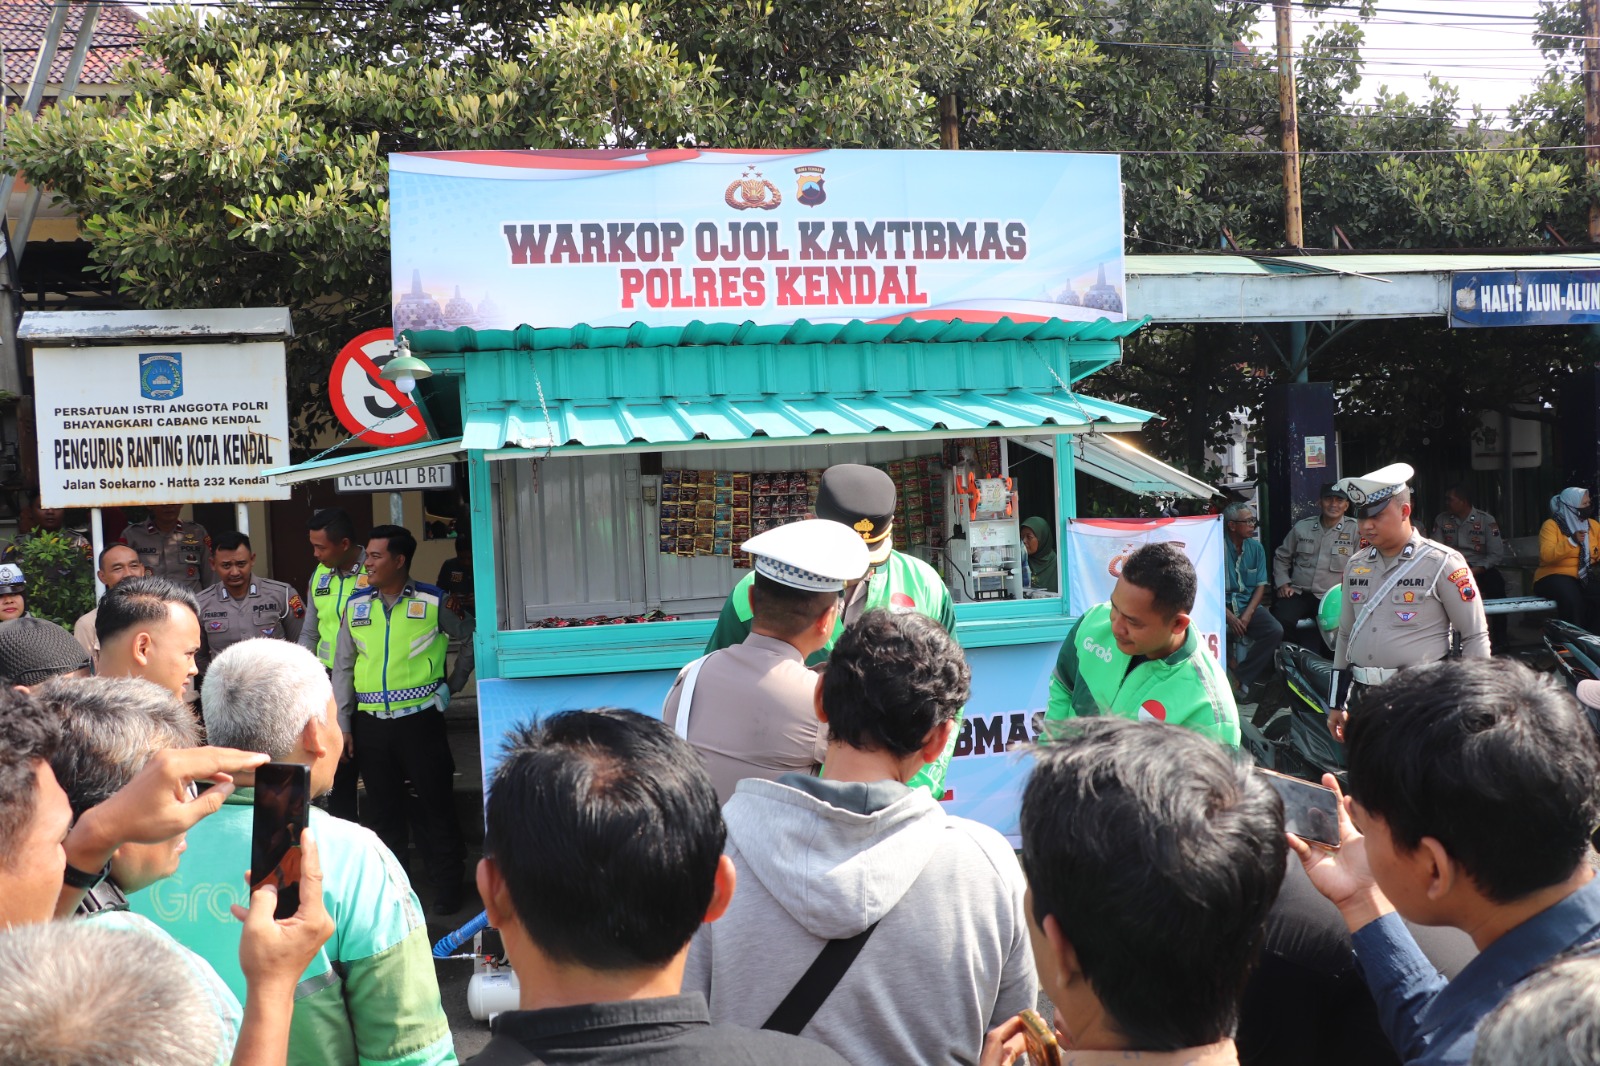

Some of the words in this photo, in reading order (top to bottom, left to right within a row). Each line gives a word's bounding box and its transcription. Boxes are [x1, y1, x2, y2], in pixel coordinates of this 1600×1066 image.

[504, 222, 684, 264] WARKOP
[695, 221, 790, 261] OJOL
[798, 221, 1027, 260] KAMTIBMAS
[620, 266, 766, 308] POLRES
[776, 265, 928, 306] KENDAL
[1481, 285, 1522, 312] HALTE
[1527, 283, 1600, 311] ALUN-ALUN
[55, 406, 129, 416] PERSATUAN
[133, 405, 165, 414] ISTRI
[169, 402, 228, 413] ANGGOTA
[232, 401, 268, 411] POLRI
[63, 418, 153, 430] BHAYANGKARI
[157, 416, 208, 427] CABANG
[213, 414, 261, 425] KENDAL
[54, 436, 123, 470] PENGURUS
[128, 434, 183, 468] RANTING
[187, 434, 220, 467] KOTA
[223, 433, 273, 465] KENDAL
[62, 478, 96, 491] Jalan
[99, 478, 156, 489] Soekarno
[167, 477, 200, 488] Hatta
[203, 477, 225, 486] 232
[229, 475, 270, 486] Kendal
[344, 468, 408, 487] KECUALI
[417, 466, 445, 484] BRT
[1396, 578, 1424, 587] POLRI
[253, 603, 277, 612] POLRI
[1083, 636, 1113, 663] Grab
[151, 873, 250, 924] Gra
